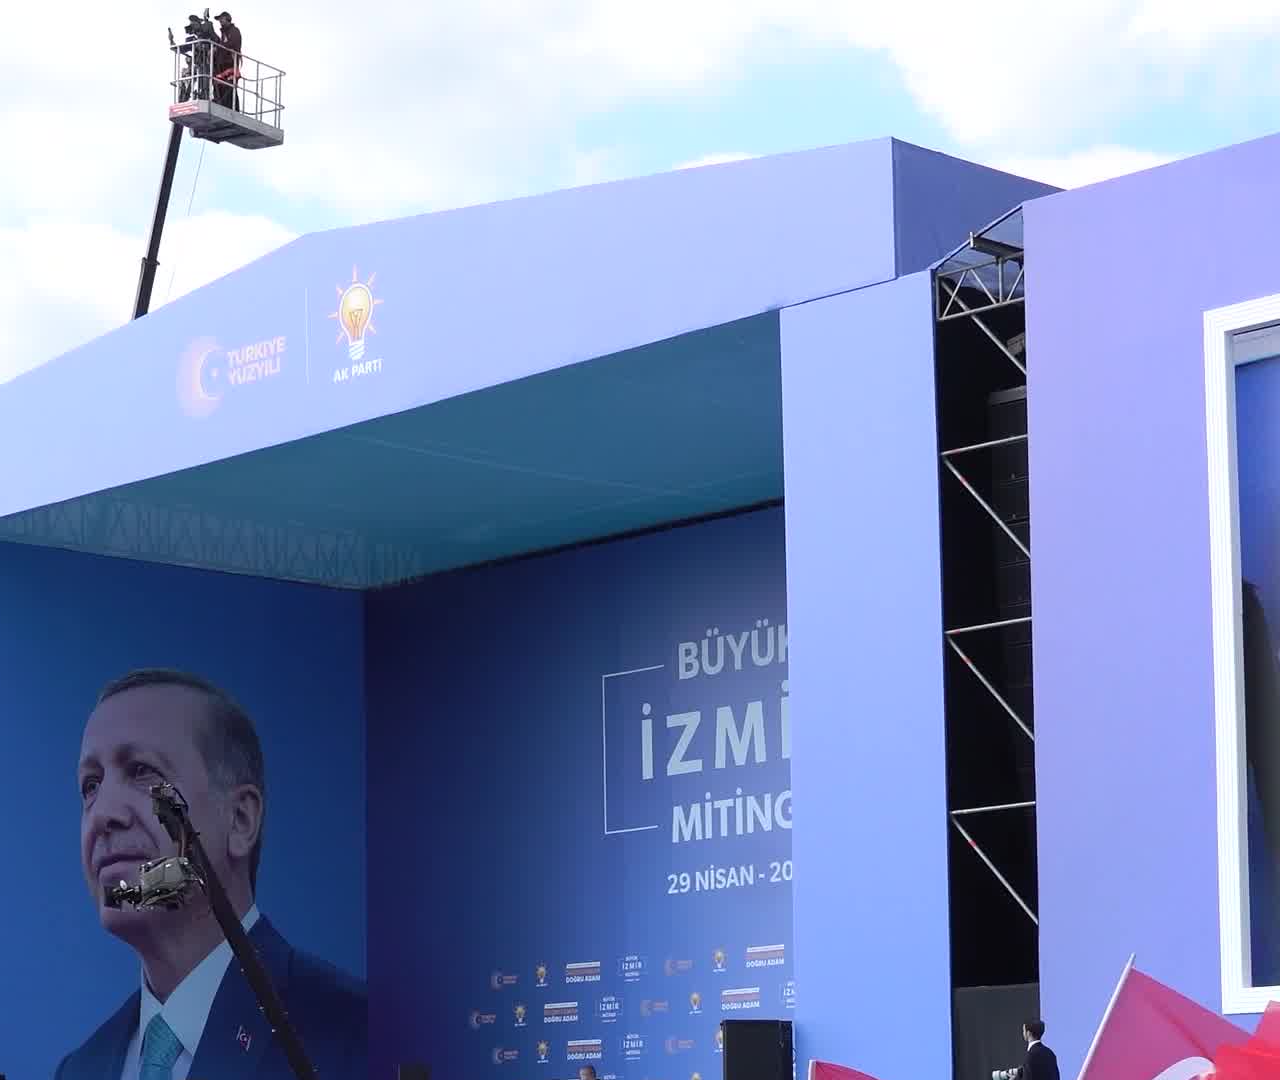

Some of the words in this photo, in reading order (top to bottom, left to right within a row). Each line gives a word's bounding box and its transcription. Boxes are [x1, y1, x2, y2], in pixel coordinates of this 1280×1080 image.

[333, 367, 349, 383] AK
[667, 872, 690, 894] 29
[695, 864, 754, 892] NİSAN
[770, 860, 793, 883] 20
